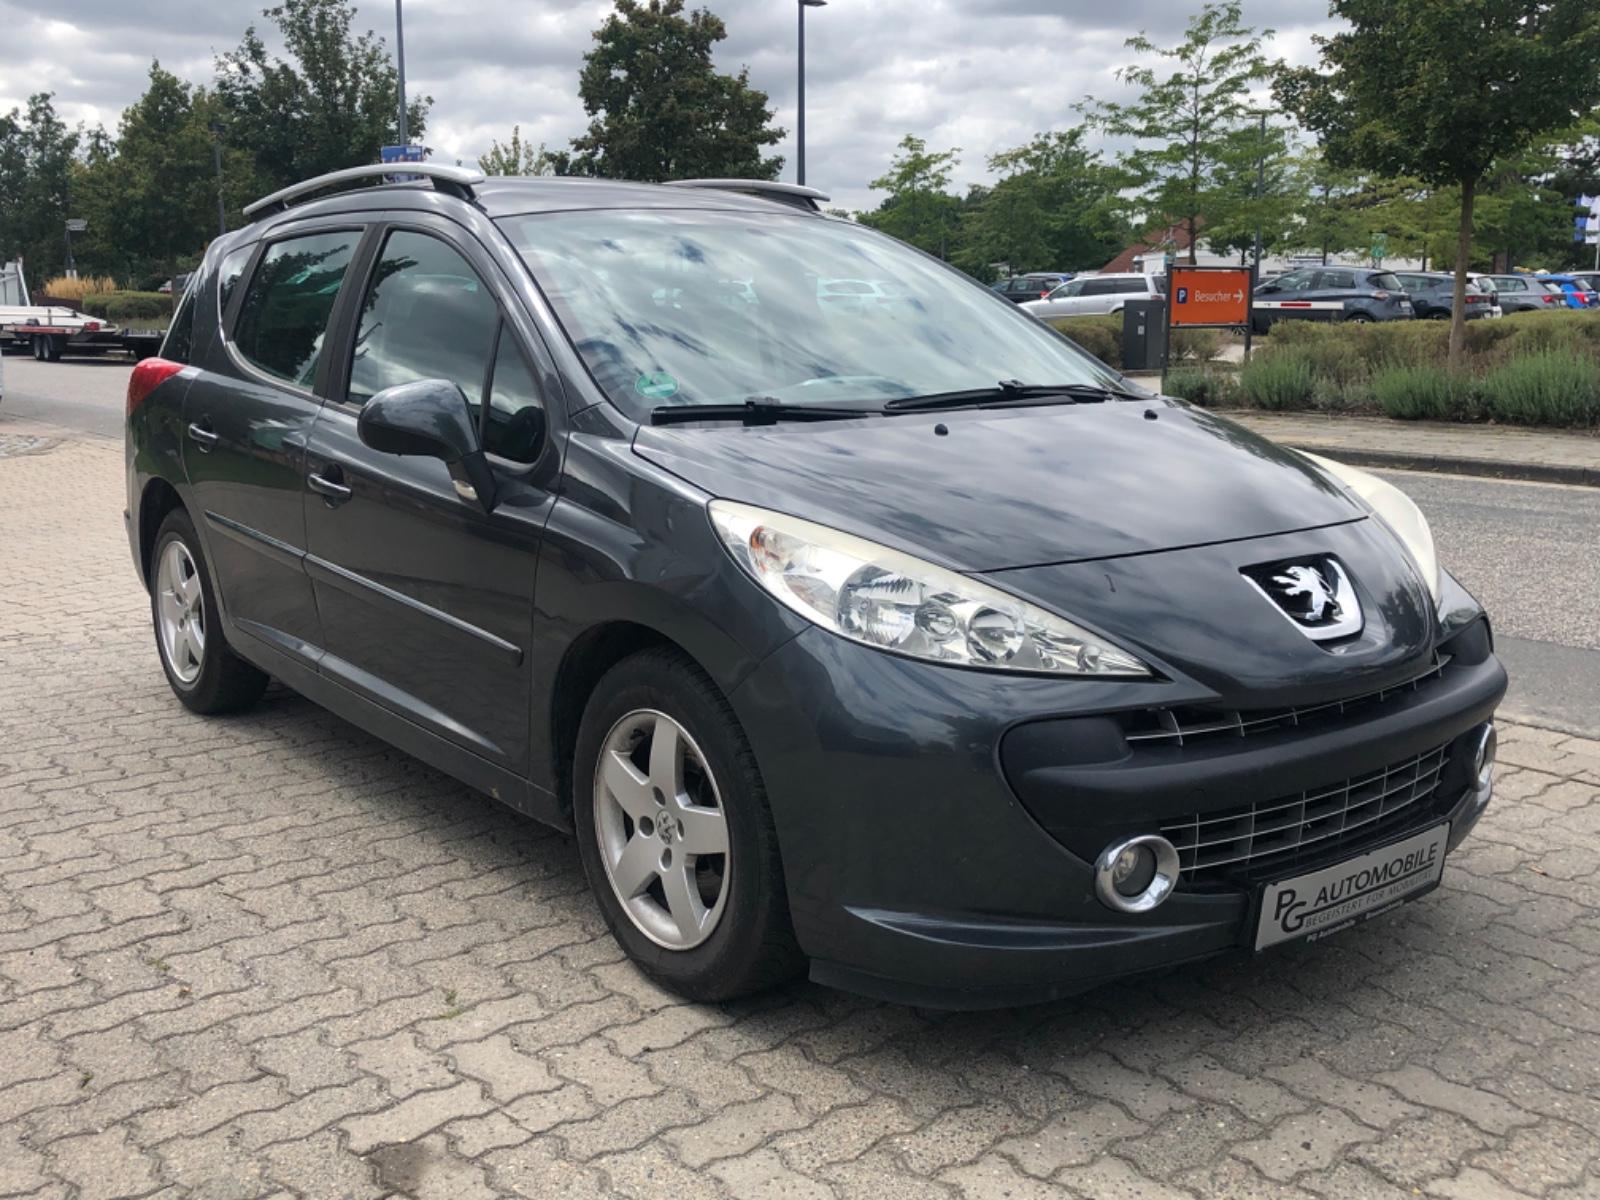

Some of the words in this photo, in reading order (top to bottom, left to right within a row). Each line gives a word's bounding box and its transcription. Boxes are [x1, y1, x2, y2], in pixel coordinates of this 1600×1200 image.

[1178, 289, 1187, 302] P
[1194, 289, 1232, 303] Besucher
[1274, 888, 1307, 933] PG
[1313, 842, 1439, 908] AUTOMOBILE
